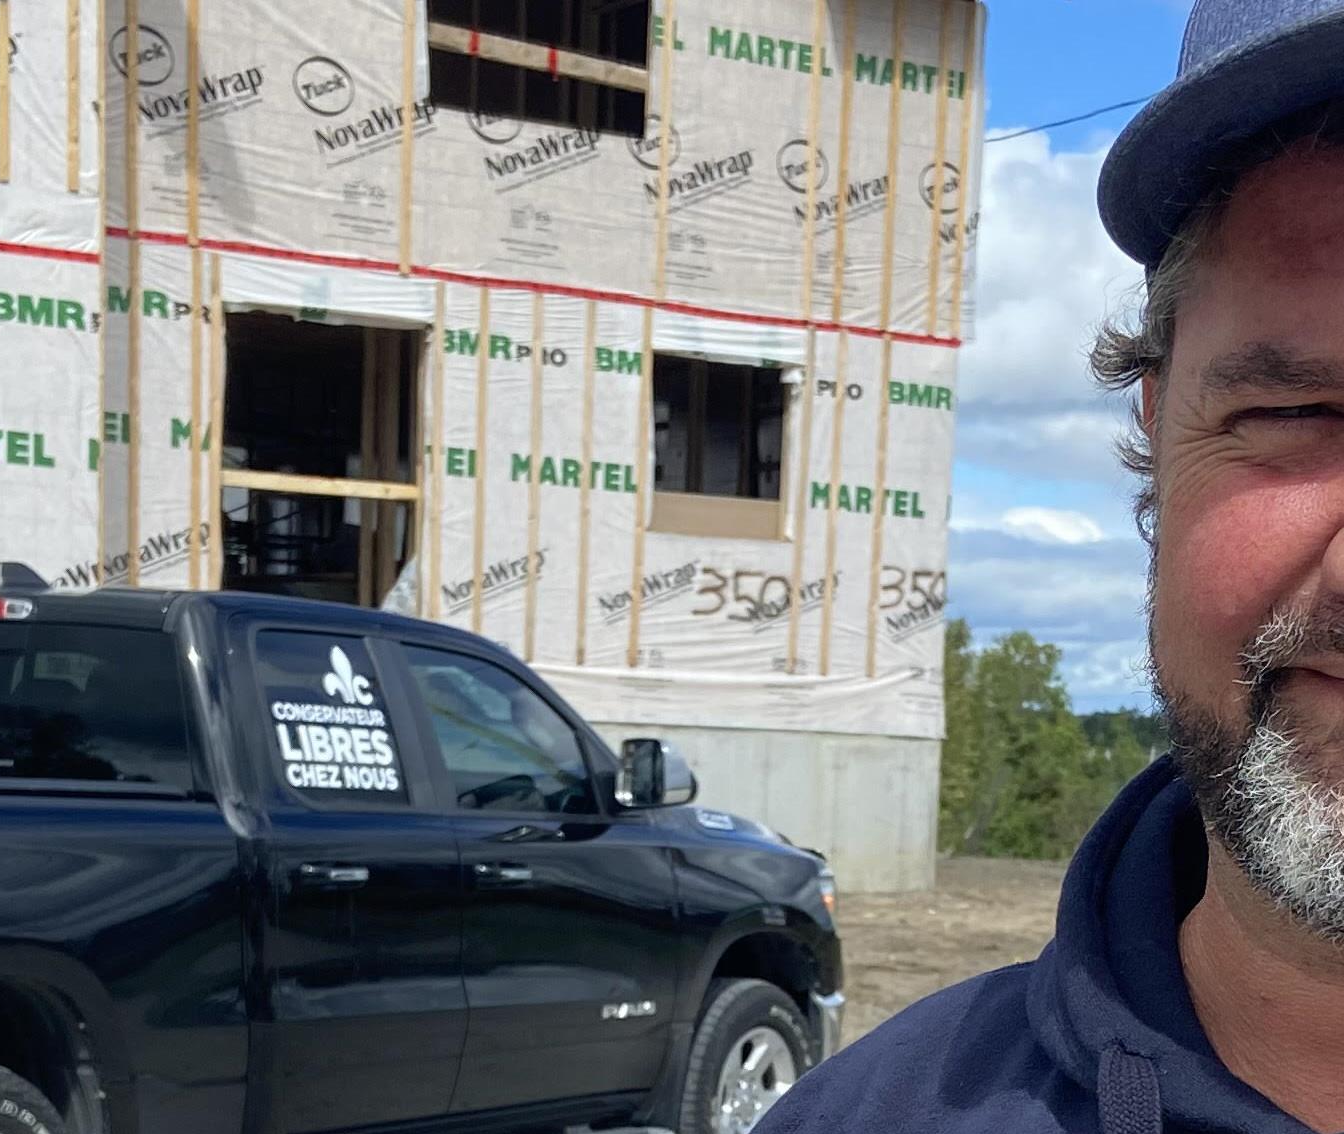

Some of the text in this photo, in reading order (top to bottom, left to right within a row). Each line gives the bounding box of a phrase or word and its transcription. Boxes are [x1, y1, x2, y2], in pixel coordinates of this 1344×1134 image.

[709, 26, 833, 77] MARTEL
[302, 74, 346, 100] Tuck
[888, 380, 953, 411] BMR
[510, 452, 638, 494] MARTEL
[811, 480, 927, 520] MARTEL
[690, 567, 793, 622] 350
[271, 701, 386, 727] CONSERVATEUR
[276, 723, 394, 766] LIBRES
[286, 763, 399, 791] CHEZ NOUS
